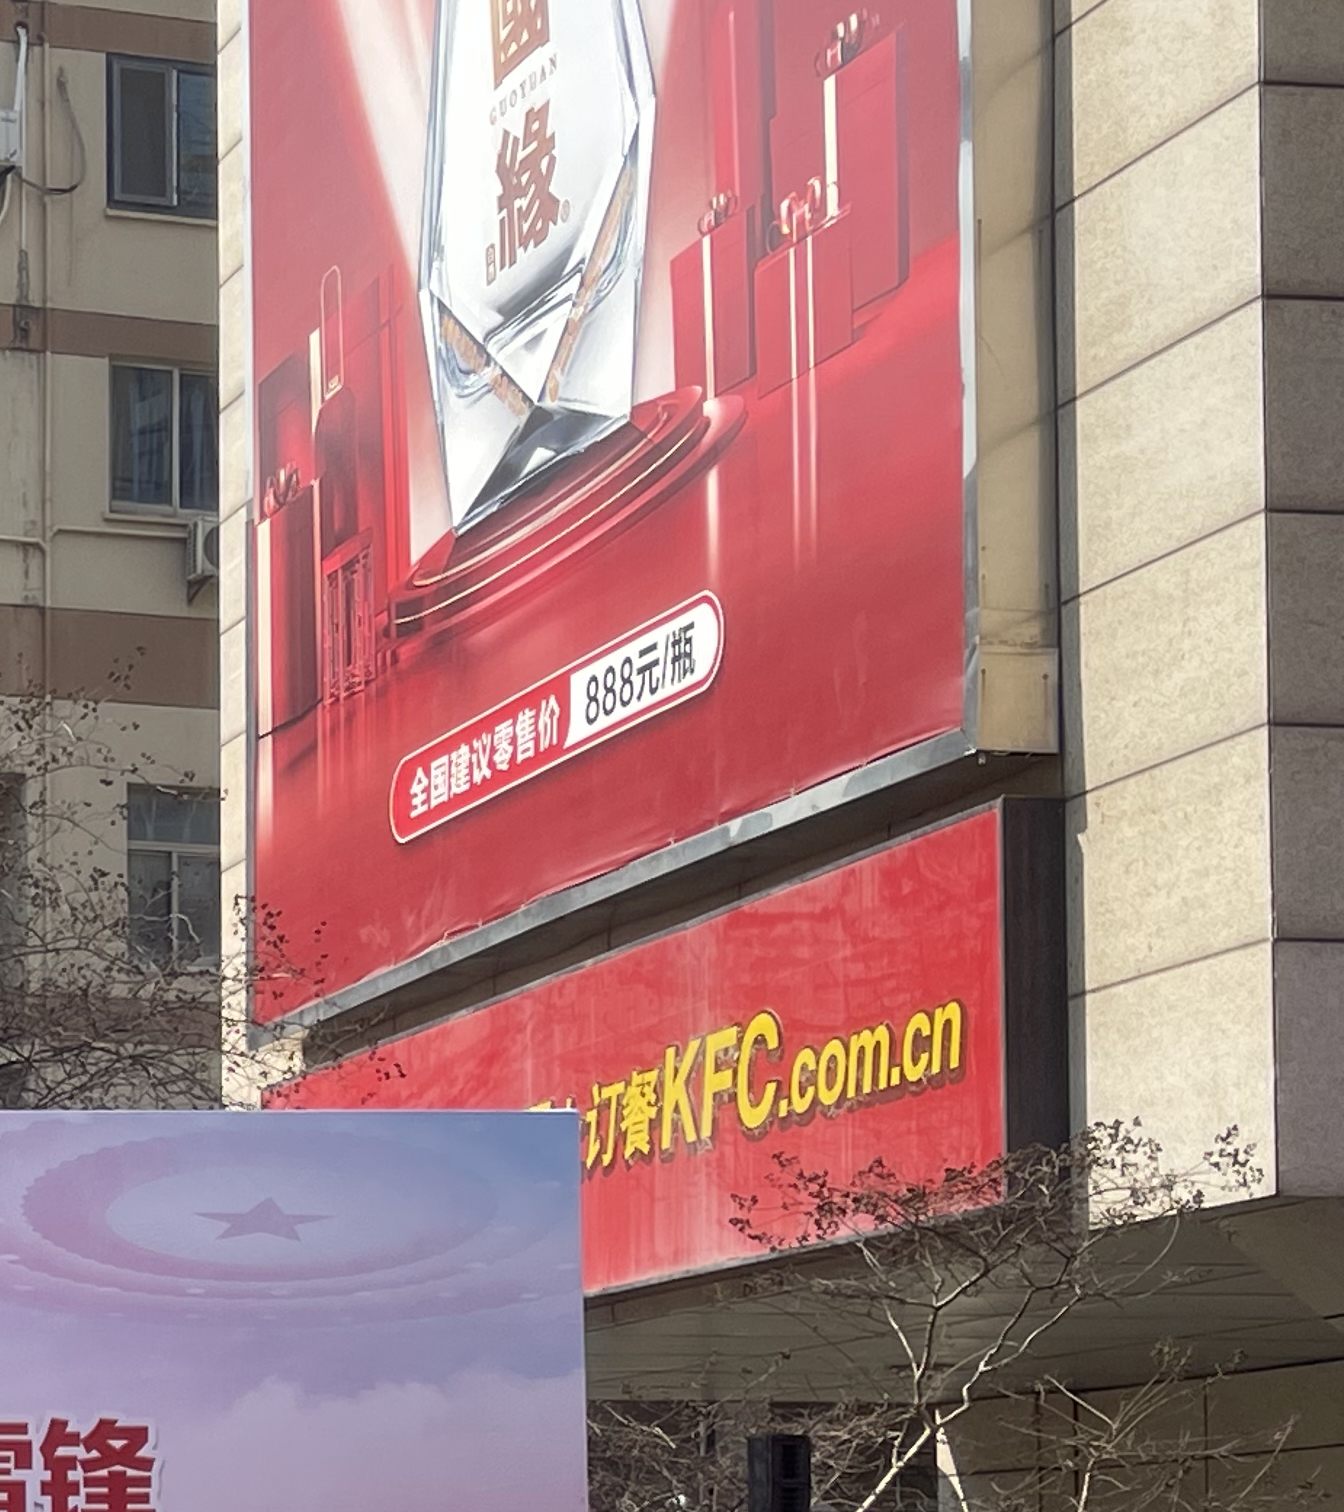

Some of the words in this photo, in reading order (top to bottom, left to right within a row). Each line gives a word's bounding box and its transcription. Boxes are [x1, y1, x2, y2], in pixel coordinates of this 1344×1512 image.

[489, 53, 558, 126] GUOYUAN
[584, 621, 696, 726] 888元/瓶
[409, 694, 561, 819] 全国建议零售价
